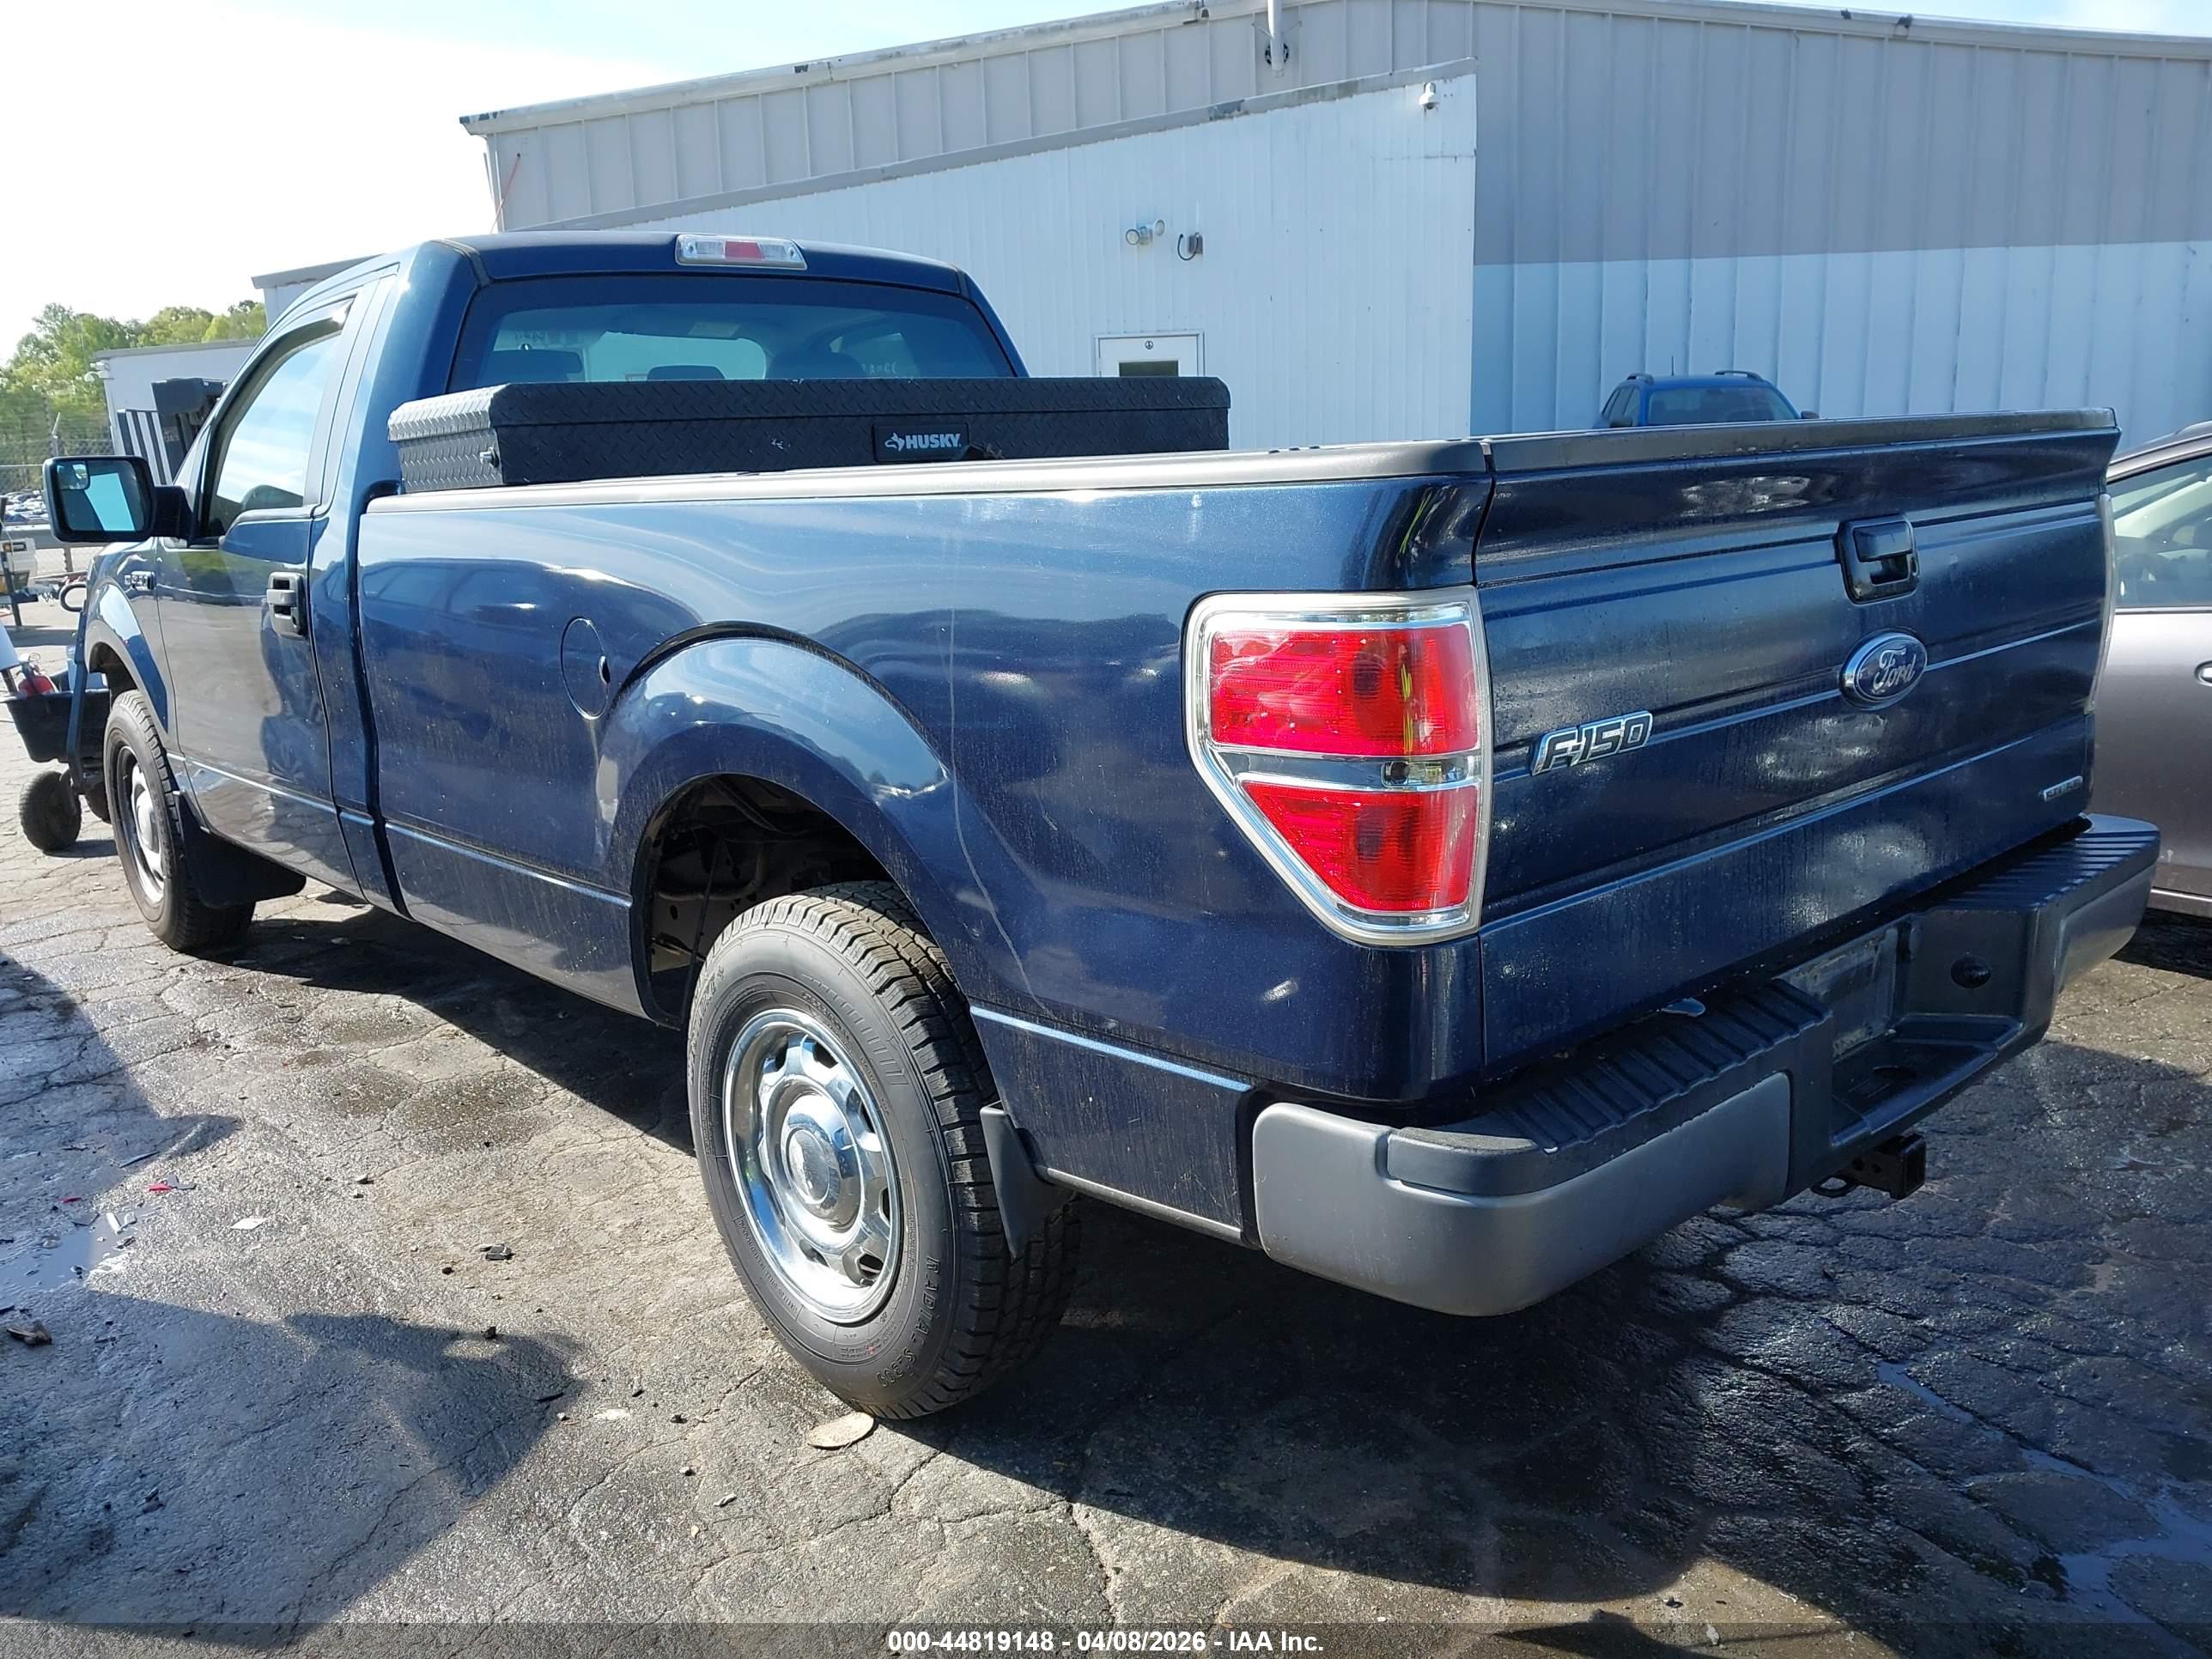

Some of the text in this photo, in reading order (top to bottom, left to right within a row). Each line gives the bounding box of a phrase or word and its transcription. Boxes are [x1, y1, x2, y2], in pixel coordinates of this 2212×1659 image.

[905, 433, 961, 449] HUSKY
[1873, 646, 1917, 690] Ford
[1533, 710, 1654, 775] F-150
